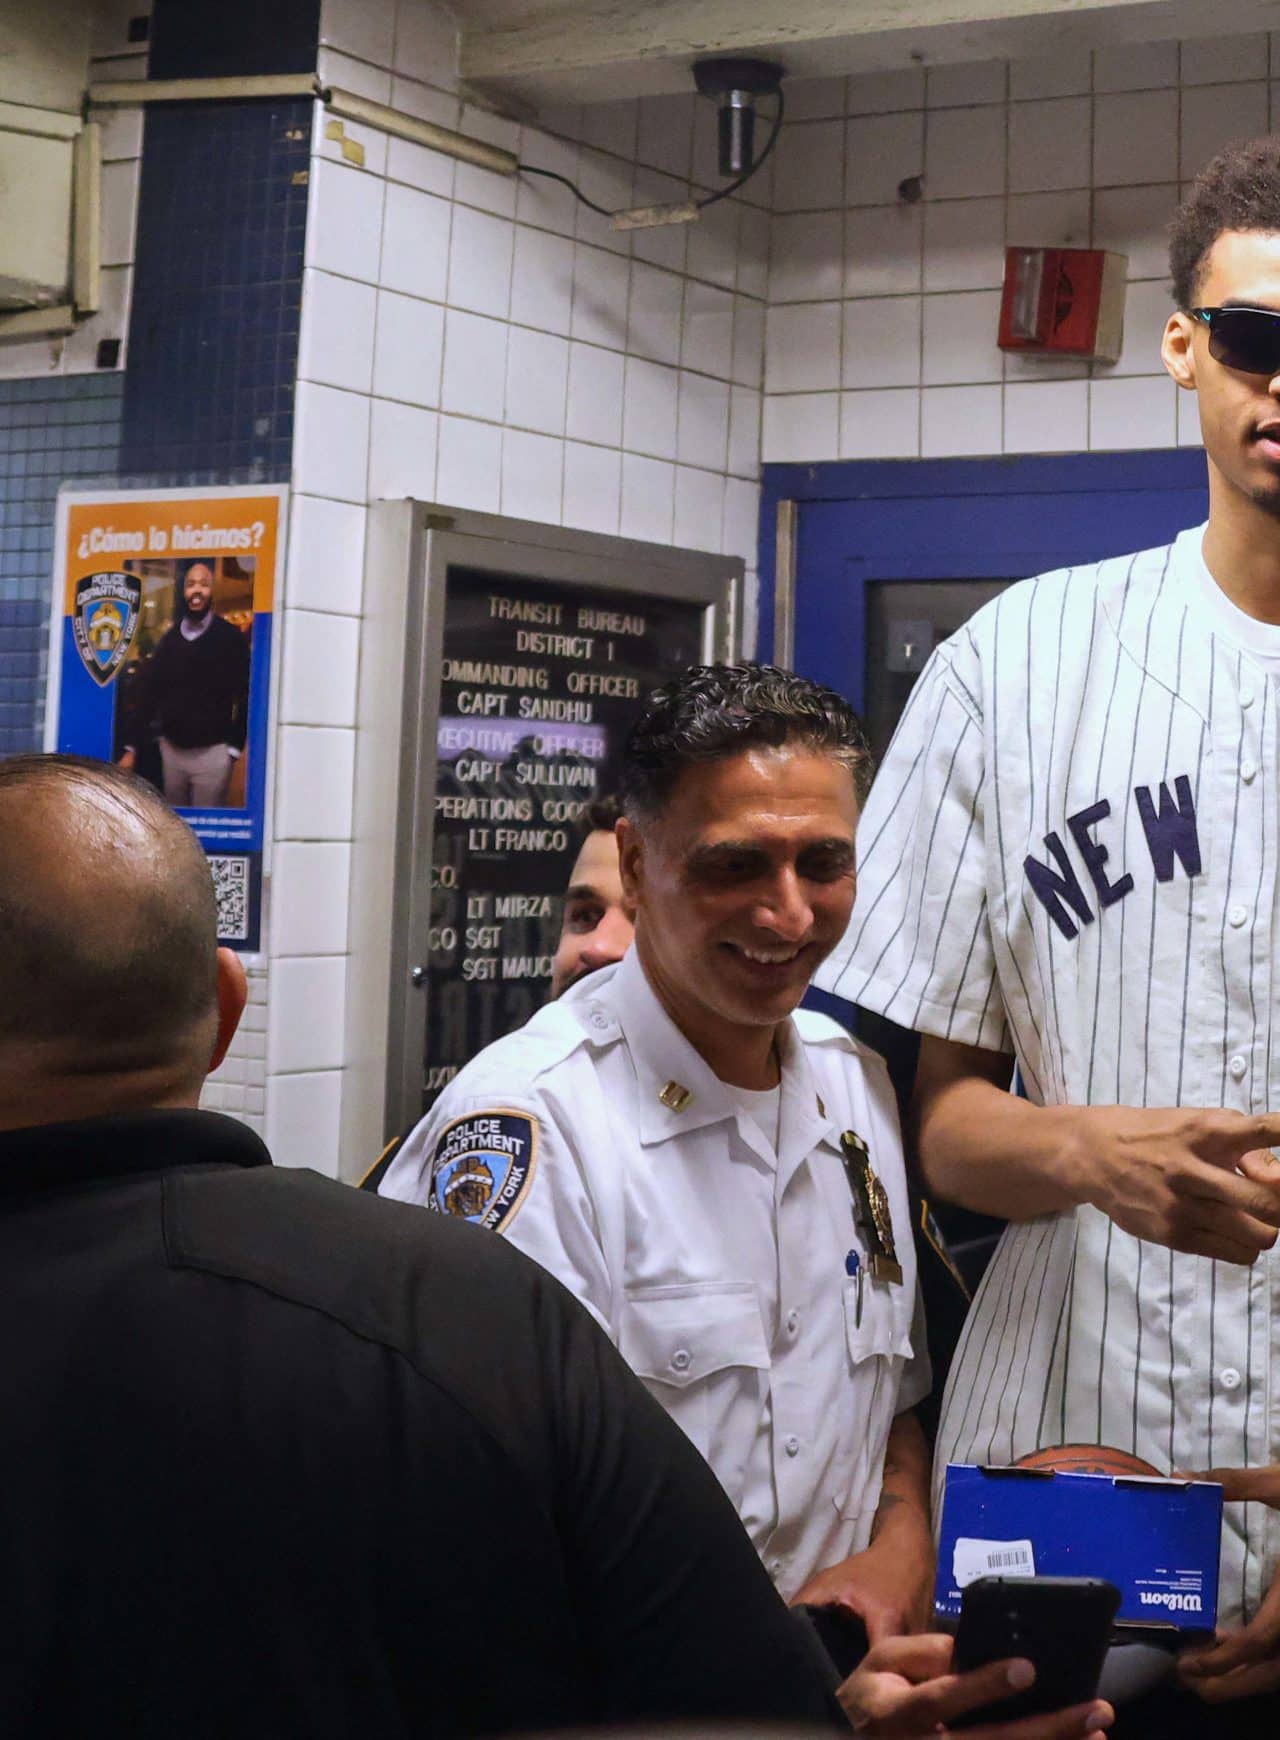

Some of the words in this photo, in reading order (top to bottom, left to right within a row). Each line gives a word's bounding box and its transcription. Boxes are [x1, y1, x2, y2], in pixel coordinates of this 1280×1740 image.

[78, 527, 145, 559] ¿Cómo
[149, 526, 168, 551] lo
[171, 521, 265, 550] hicimos?
[91, 573, 127, 587] POLICE
[77, 584, 139, 606] DEPARTMENT
[488, 596, 563, 625] TRANSIT
[577, 608, 646, 636] BUREAU
[516, 630, 595, 660] DISTRICT
[566, 671, 640, 699] OFFICER
[457, 690, 508, 717] CAPT
[518, 695, 594, 724] SANDHU
[533, 734, 606, 760] OFFICER
[455, 758, 503, 783] CAPT
[515, 762, 597, 788] SULLIVAN
[468, 827, 489, 850] LT
[495, 828, 568, 851] FRANCO
[1023, 773, 1203, 942] NEW
[466, 896, 488, 919] LT
[495, 896, 551, 918] MIRZA
[465, 926, 502, 950] SGT
[463, 957, 496, 981] SGT
[446, 1119, 501, 1148] POLICE
[497, 1166, 525, 1208] YORK
[1139, 1591, 1203, 1612] Wilson
